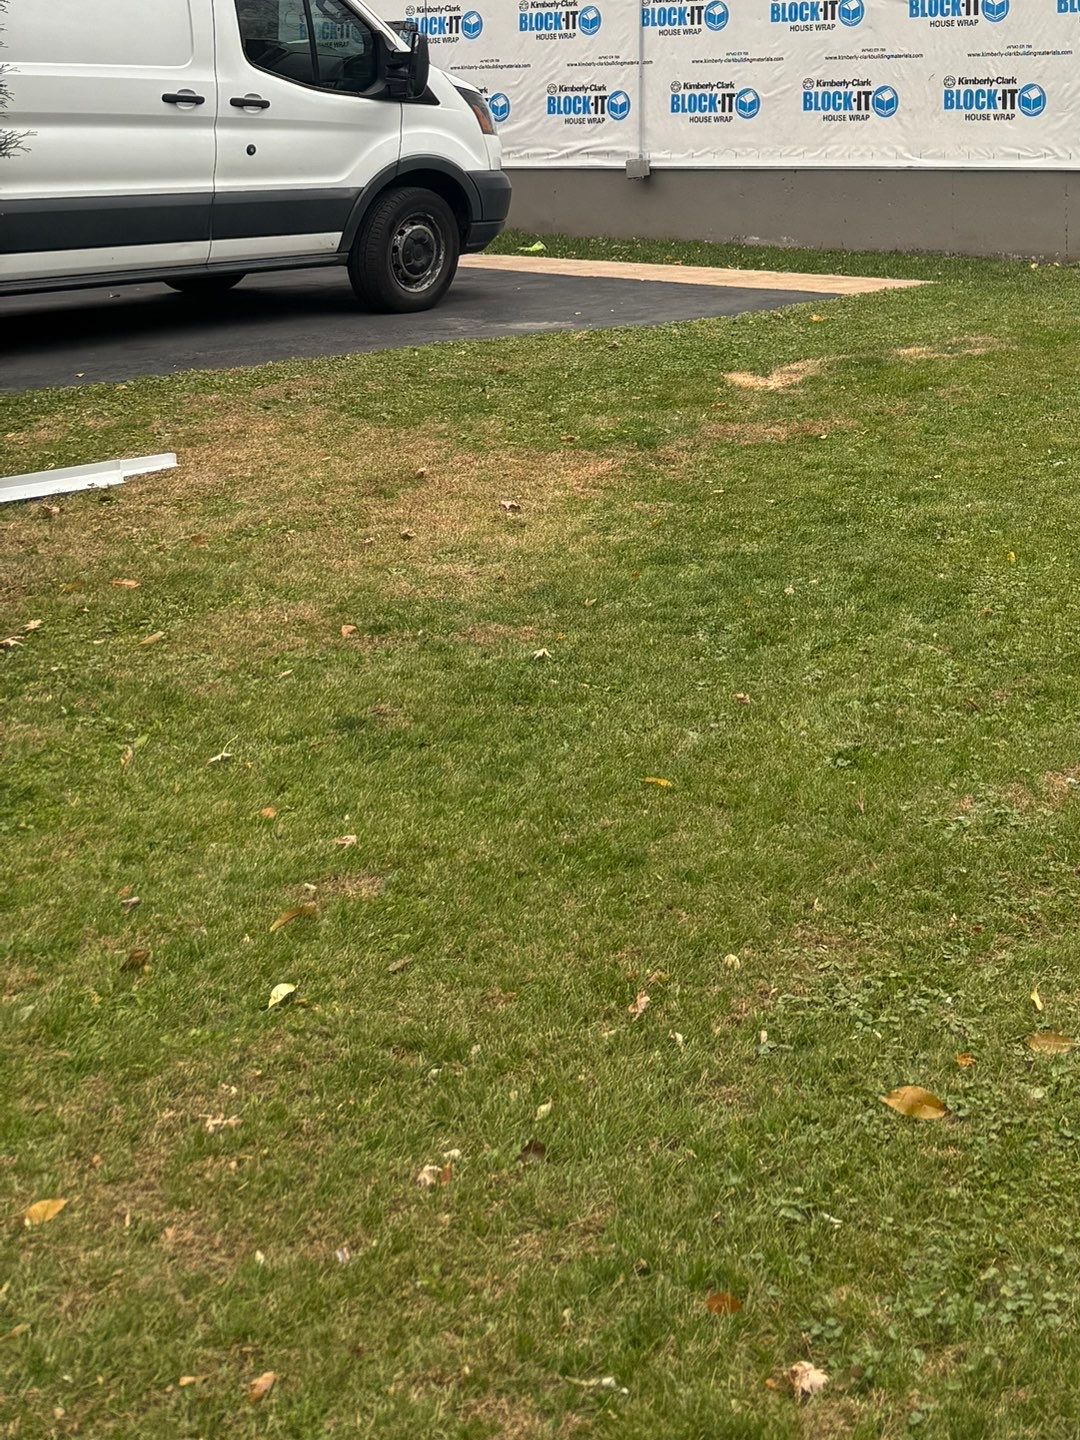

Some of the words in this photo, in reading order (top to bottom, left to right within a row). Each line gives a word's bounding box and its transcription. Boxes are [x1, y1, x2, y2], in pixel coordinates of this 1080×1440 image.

[790, 24, 813, 32] HOUSE
[814, 23, 836, 31] WRAP
[929, 20, 954, 28] HOUSE
[955, 19, 979, 27] WRAP
[536, 32, 557, 41] HOUSE
[565, 117, 584, 125] HOUSE
[585, 116, 605, 124] WRAP
[689, 115, 712, 123] HOUSE
[713, 114, 733, 122] WRAP
[822, 114, 848, 122] HOUSE
[848, 113, 870, 122] WRAP
[964, 113, 991, 122] HOUSE
[992, 113, 1015, 121] WRAP
